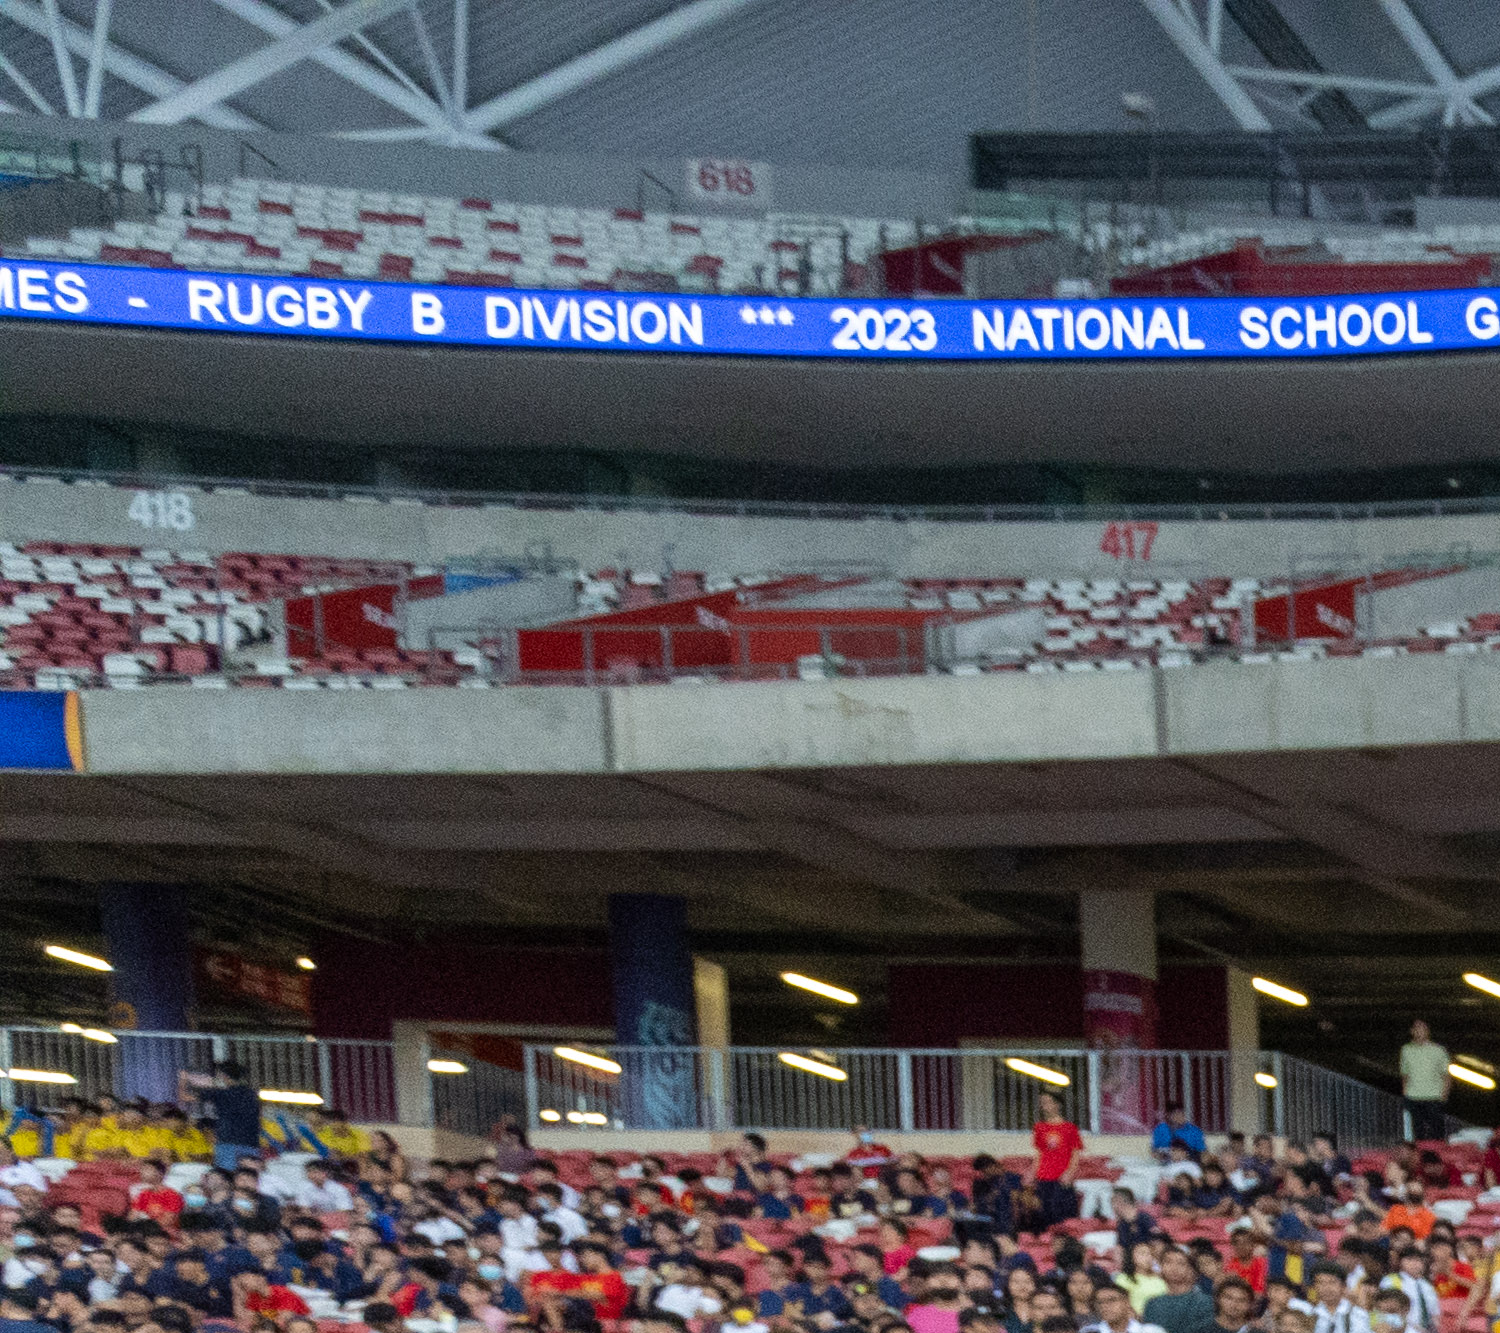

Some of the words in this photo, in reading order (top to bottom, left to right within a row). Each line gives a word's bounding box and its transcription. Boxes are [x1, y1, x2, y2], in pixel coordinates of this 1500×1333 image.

[698, 159, 755, 196] 618
[188, 279, 373, 331] RUGBY
[411, 292, 445, 335] B
[485, 295, 704, 345] DIVISION
[830, 307, 938, 351] 2023
[972, 307, 1206, 351] NATIONAL
[1239, 300, 1434, 350] SCHOOL
[129, 489, 196, 531] 418
[1100, 520, 1159, 560] 417
